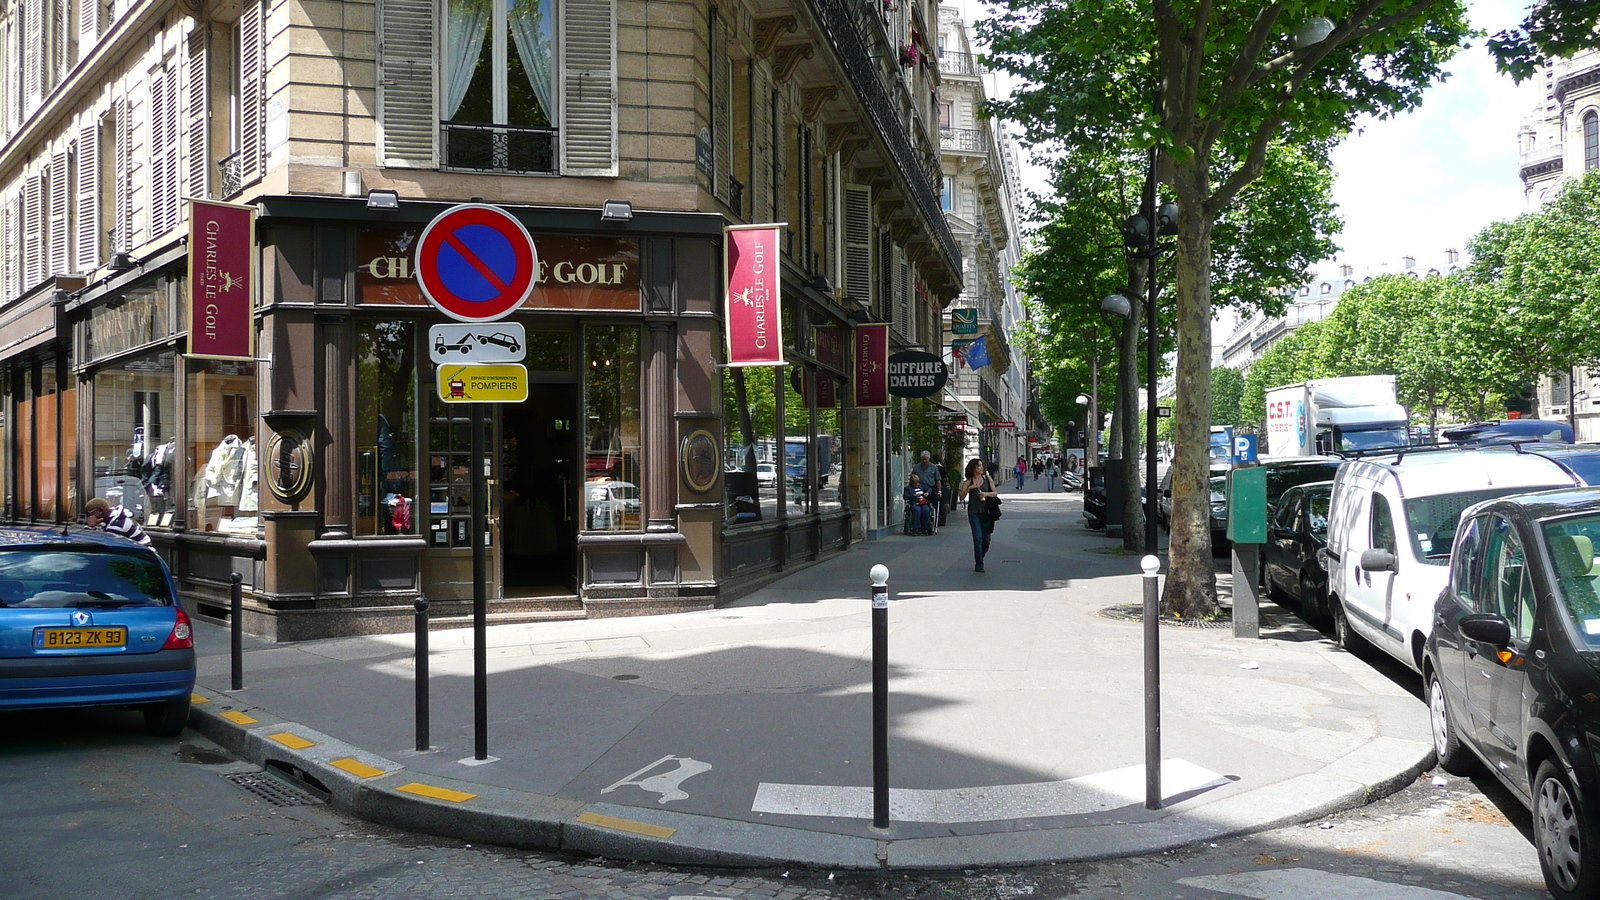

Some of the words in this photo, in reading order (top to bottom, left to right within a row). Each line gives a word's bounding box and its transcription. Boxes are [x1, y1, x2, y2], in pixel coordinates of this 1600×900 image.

[206, 220, 219, 280] CHARLES
[753, 242, 764, 274] GOLF
[553, 261, 628, 285] GOLF
[206, 284, 216, 299] LE
[755, 278, 764, 291] LE
[205, 304, 218, 339] GOLF
[755, 295, 766, 349] CHARLES
[862, 334, 870, 367] CHARLES
[862, 368, 869, 378] LE
[889, 362, 942, 374] OIFFURE
[471, 382, 518, 390] POMPIERS
[890, 375, 936, 387] DAMES
[1269, 401, 1293, 419] C.S.T.
[1234, 437, 1250, 456] P
[49, 631, 82, 645] 8123
[86, 631, 102, 644] ZK
[105, 631, 121, 644] 93
